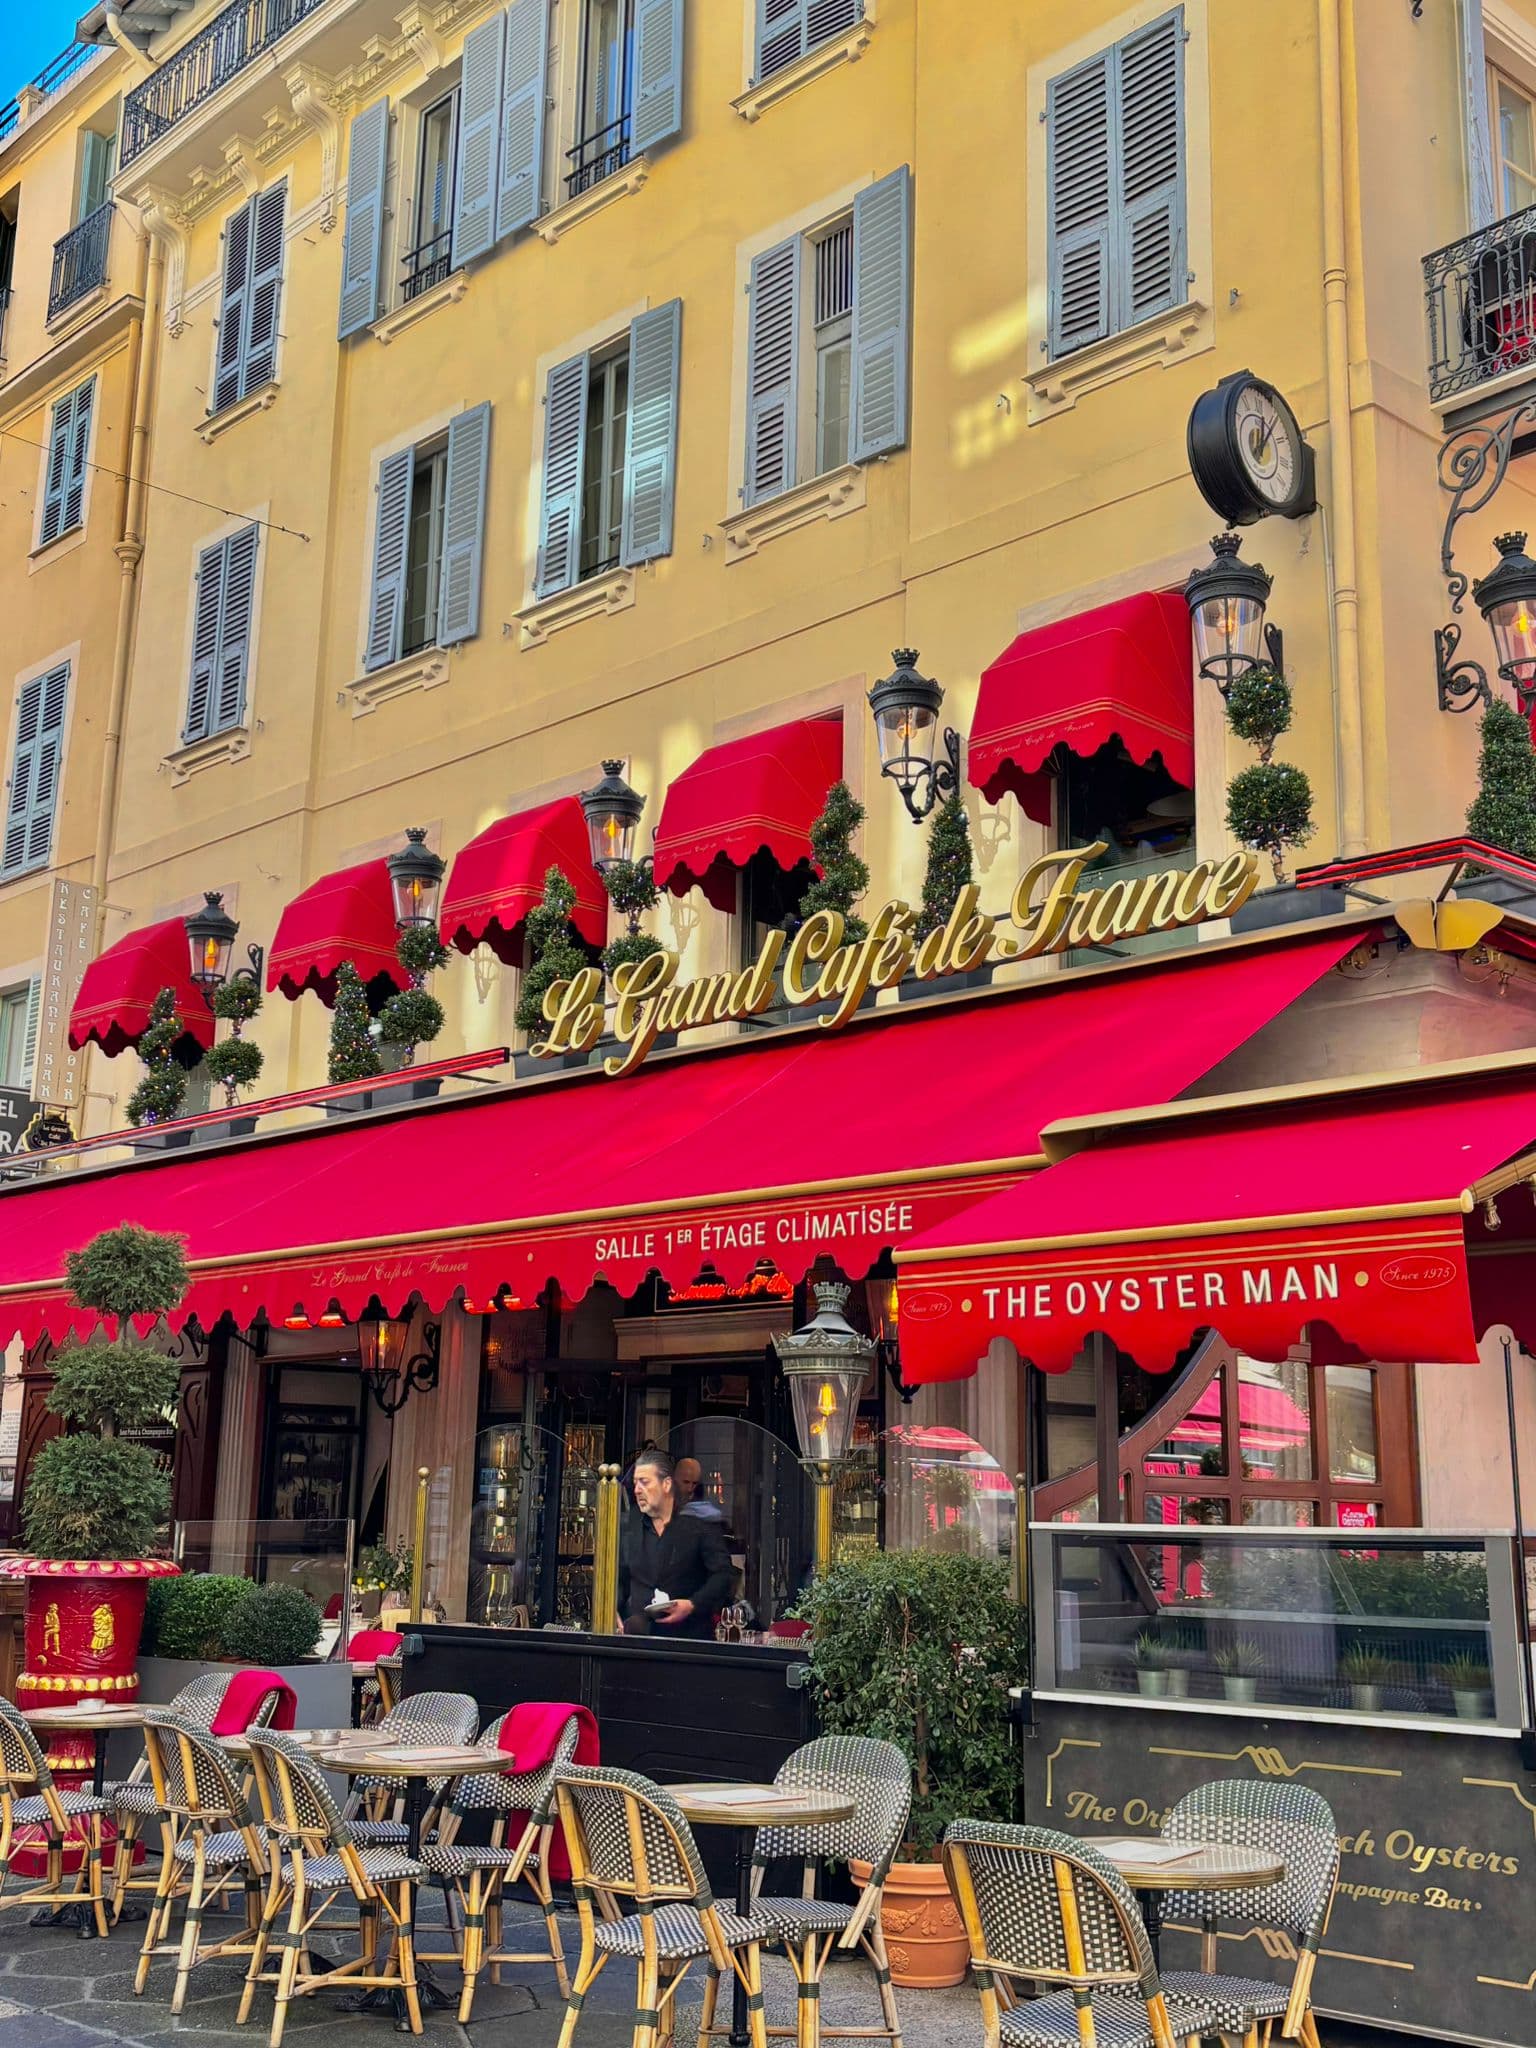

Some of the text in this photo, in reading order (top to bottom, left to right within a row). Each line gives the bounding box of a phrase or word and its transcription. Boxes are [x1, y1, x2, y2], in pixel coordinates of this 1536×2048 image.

[529, 840, 1260, 1077] Le Grand Café de France
[595, 1234, 655, 1261] SALLE
[701, 1221, 767, 1251] ÉTAGE
[311, 1271, 327, 1288] Le
[330, 1265, 372, 1288] Grand
[420, 1254, 470, 1273] France
[1383, 1265, 1451, 1281] Since 1975
[983, 1263, 1340, 1319] THE OYSTER MAN
[1065, 1791, 1173, 1829] The Ori
[1338, 1829, 1520, 1875] ch Oysters
[1335, 1880, 1471, 1912] mpagne Bar
